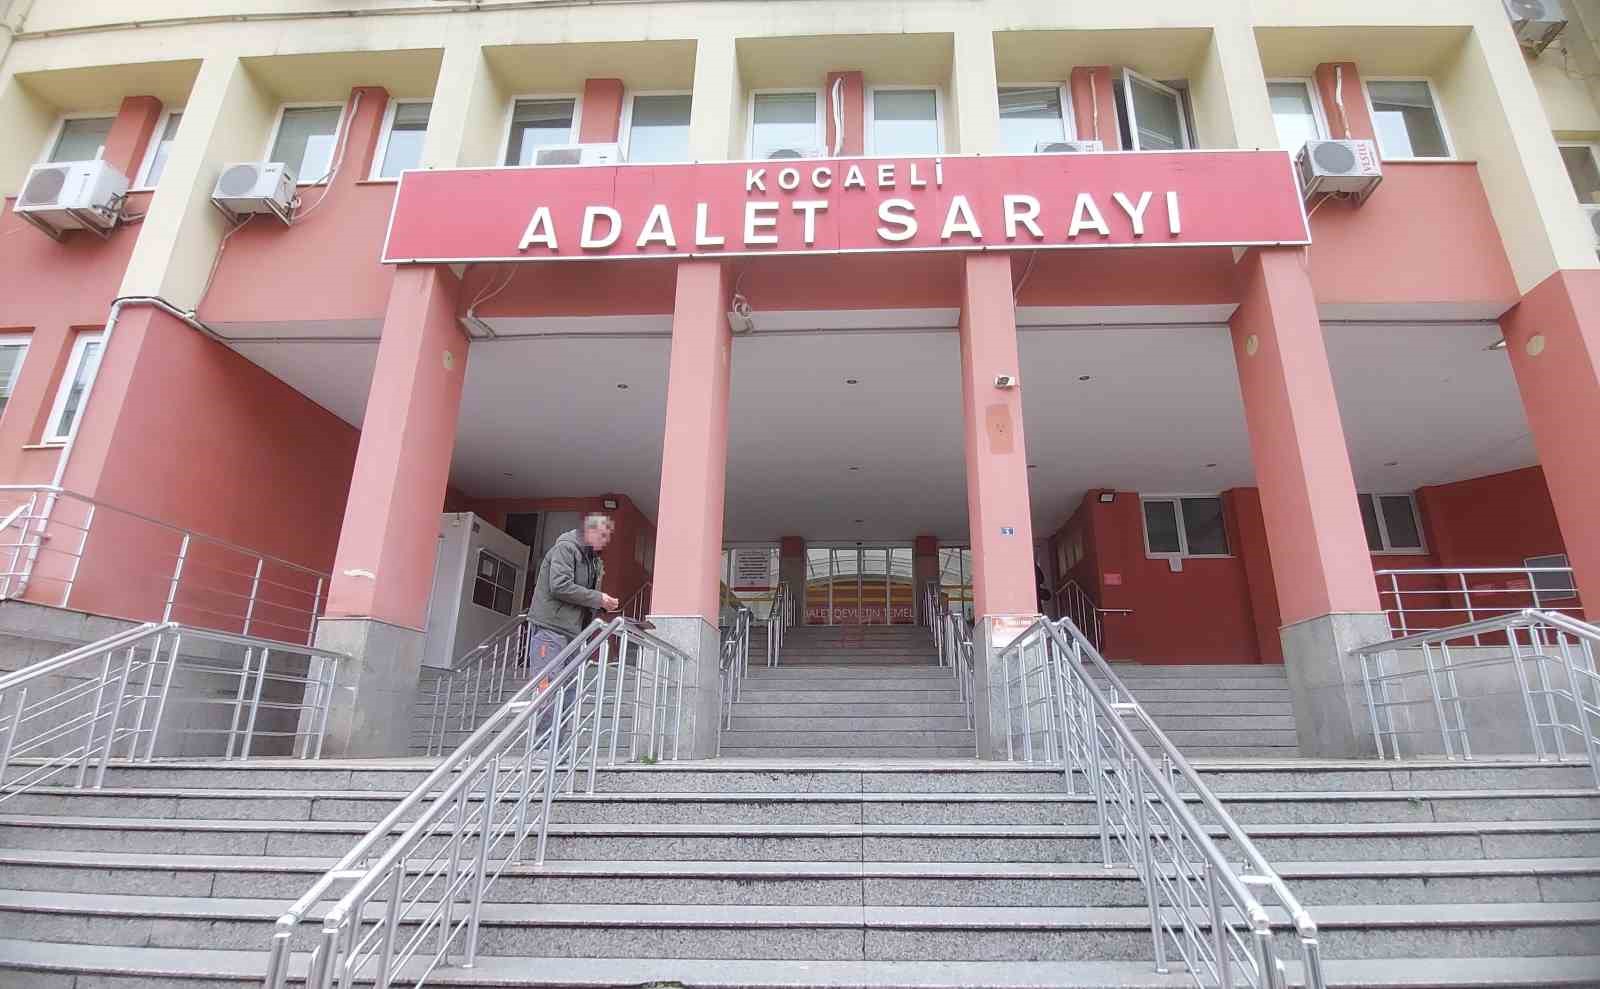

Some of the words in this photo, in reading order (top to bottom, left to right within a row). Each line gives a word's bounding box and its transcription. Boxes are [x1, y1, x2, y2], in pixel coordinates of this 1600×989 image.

[745, 157, 943, 192] KOCAELİ
[517, 198, 830, 252] ADALET
[876, 190, 1183, 242] SARAYI
